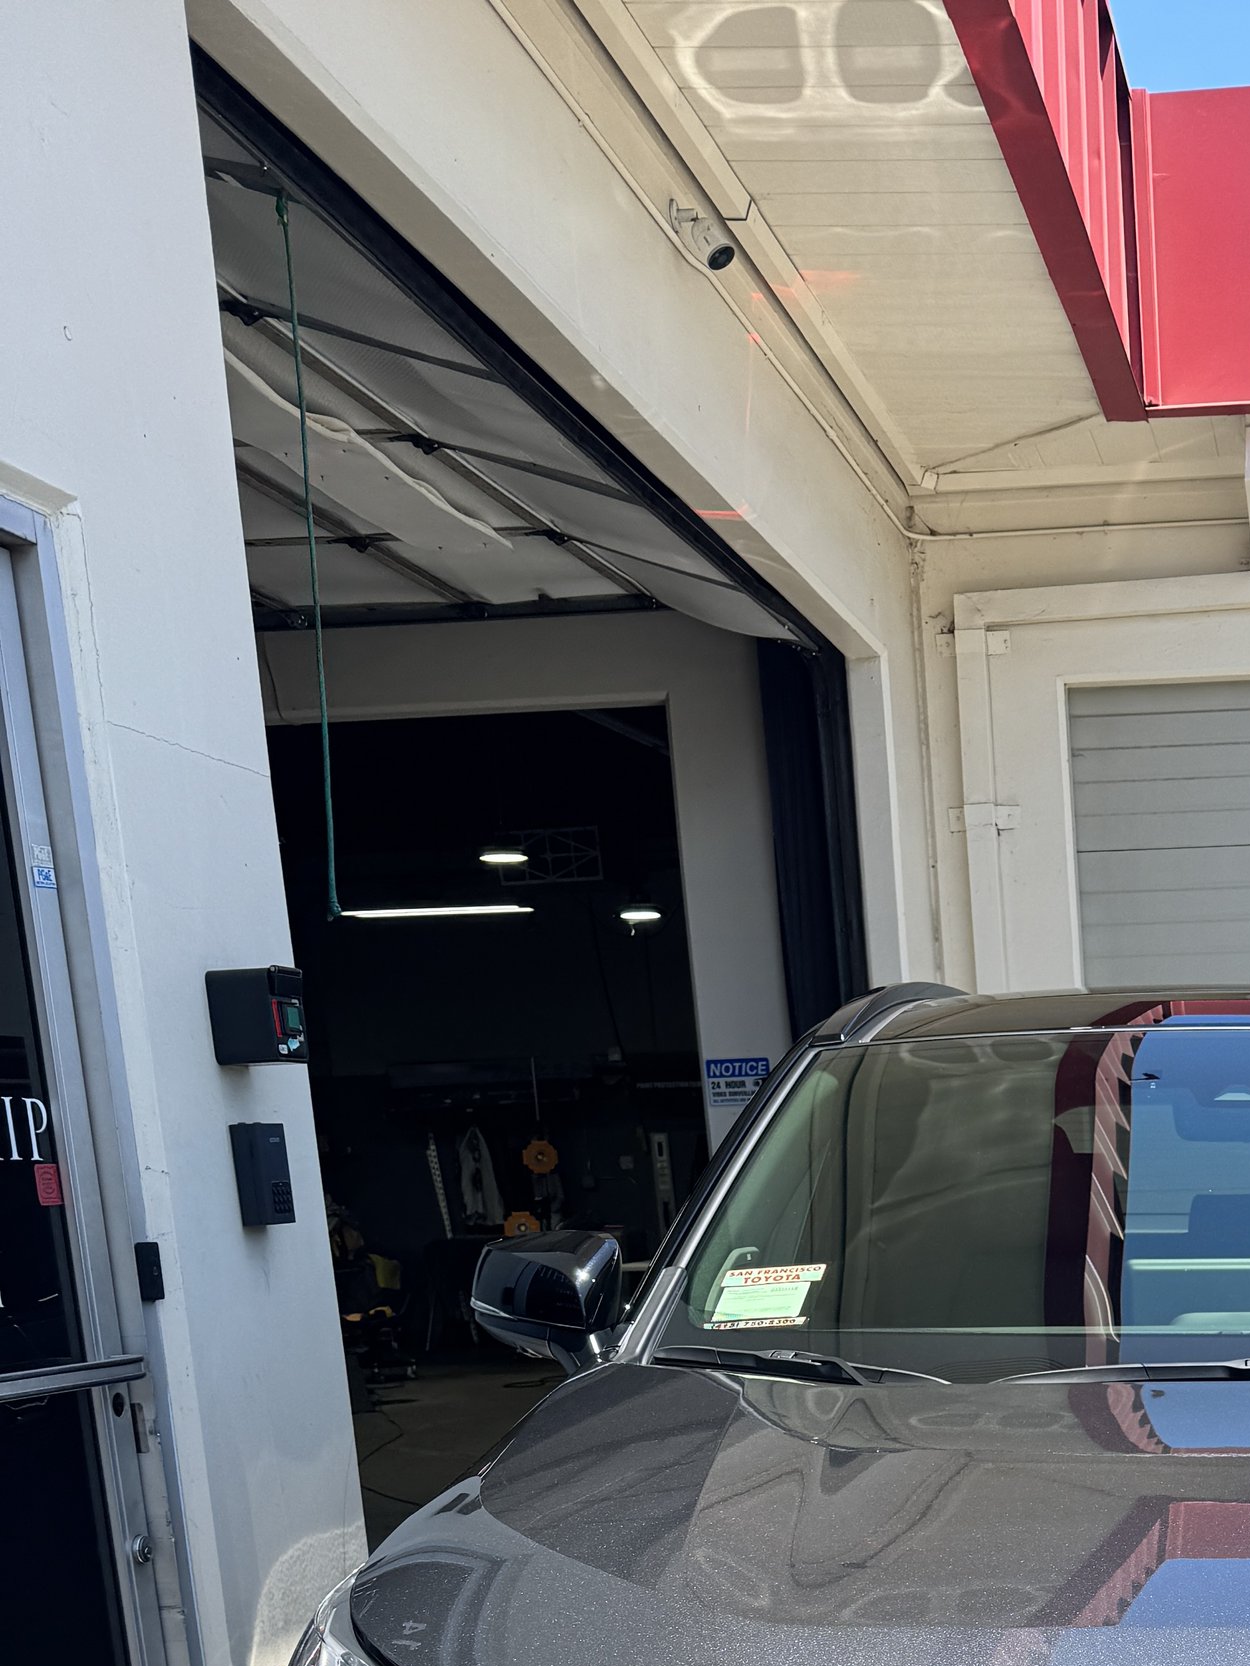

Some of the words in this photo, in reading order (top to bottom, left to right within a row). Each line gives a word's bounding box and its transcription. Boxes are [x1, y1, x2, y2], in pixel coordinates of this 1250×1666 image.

[709, 1061, 767, 1077] NOTICE
[711, 1081, 721, 1090] 24
[725, 1080, 746, 1089] HOUR
[757, 1266, 821, 1275] FRANCISCO
[743, 1274, 801, 1284] TOYOTA
